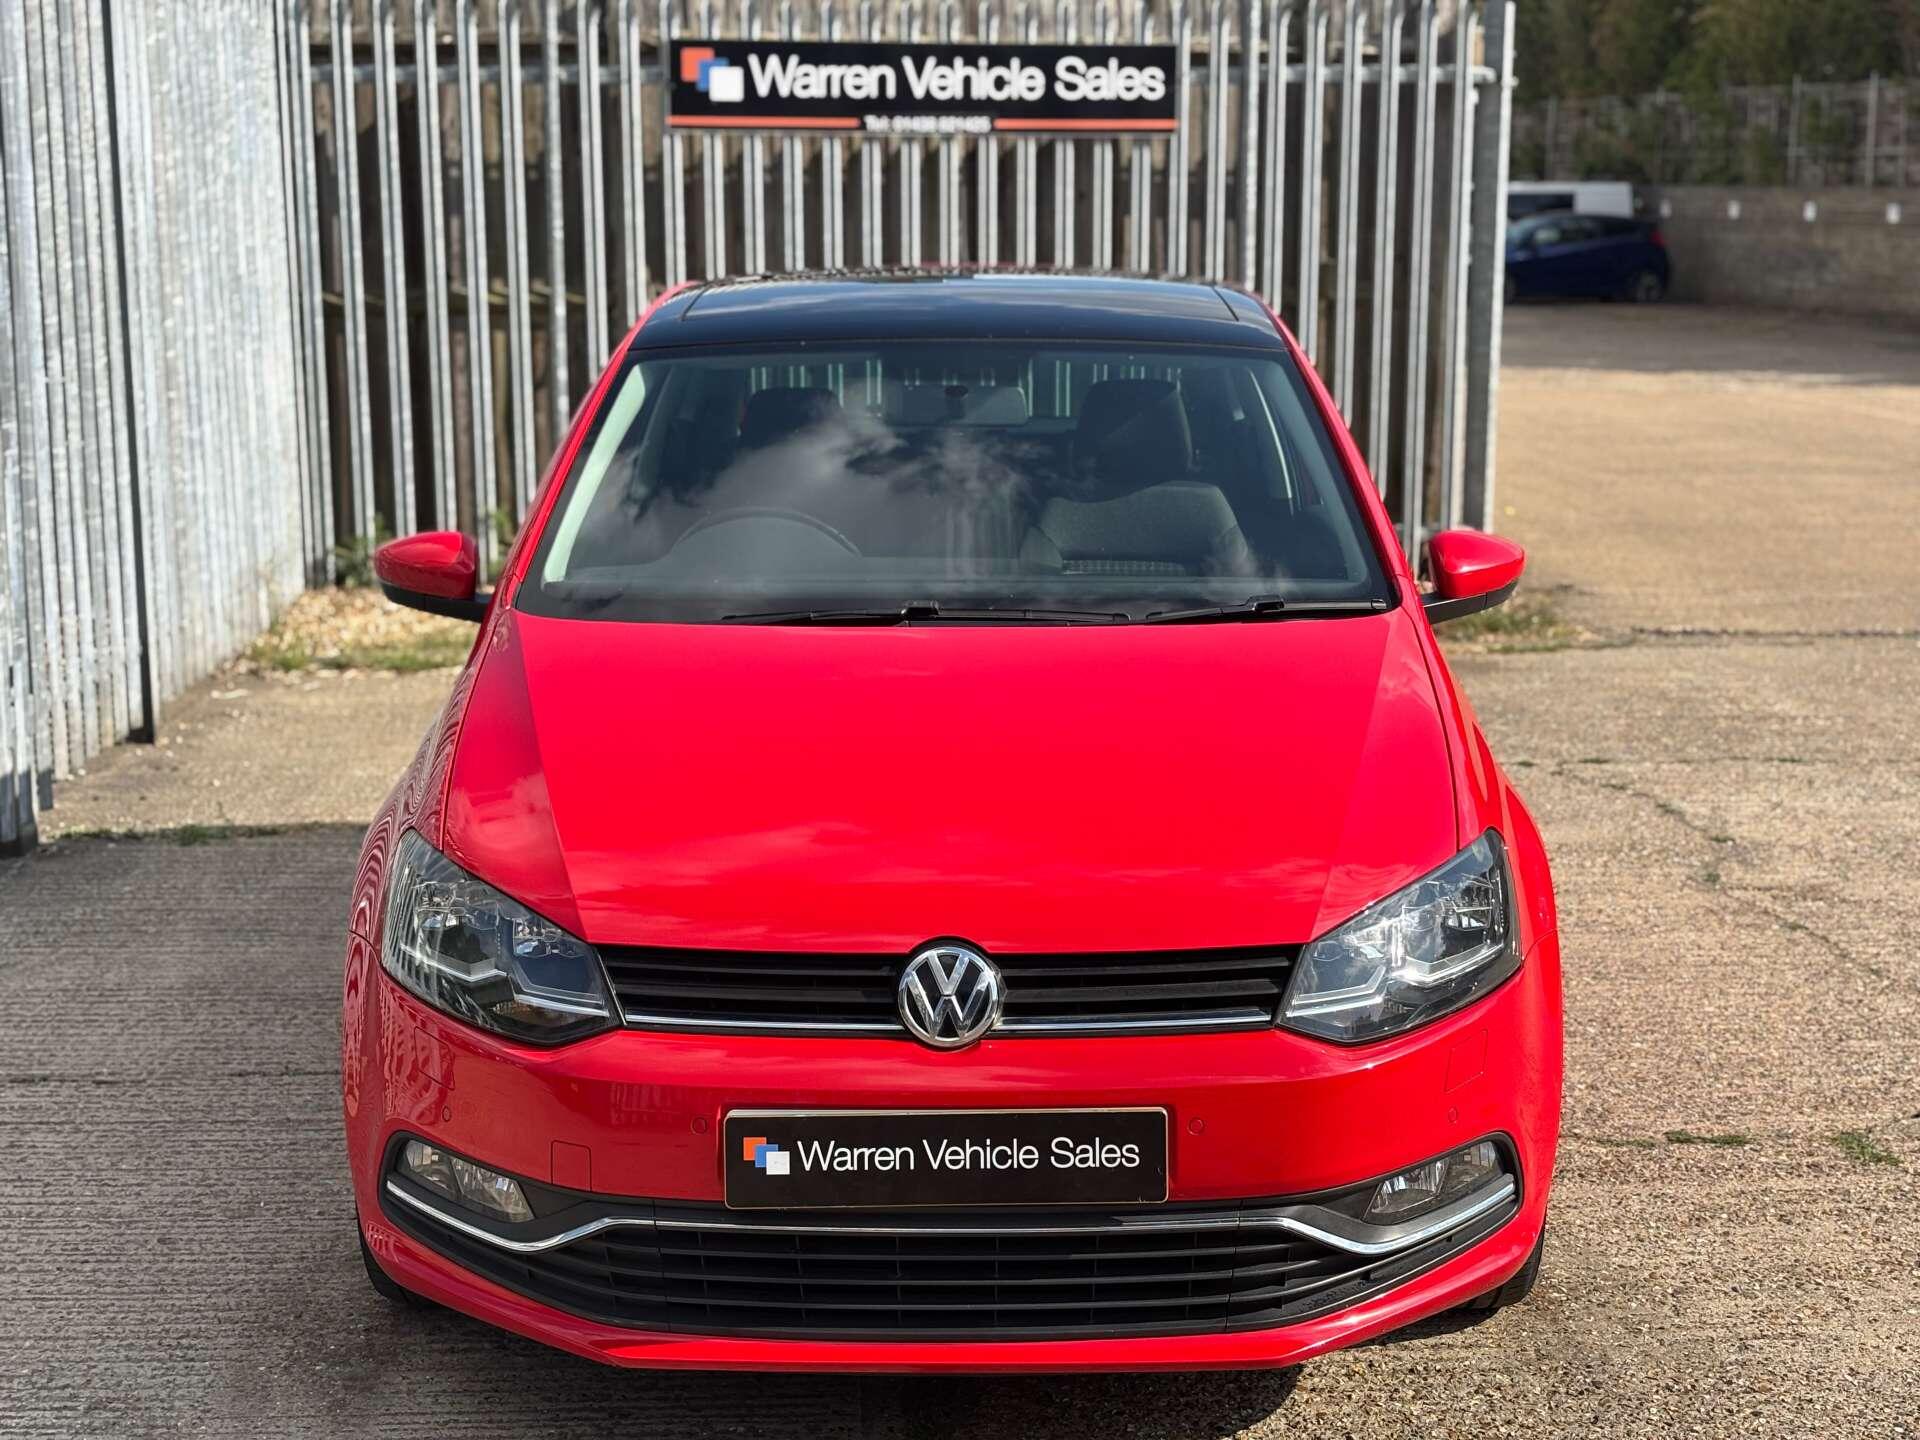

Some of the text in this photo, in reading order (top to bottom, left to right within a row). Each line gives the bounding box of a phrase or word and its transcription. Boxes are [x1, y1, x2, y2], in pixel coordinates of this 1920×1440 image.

[748, 54, 1166, 101] Warren Vehicle Sales
[797, 1136, 1140, 1172] Warren Vehicle Sales
